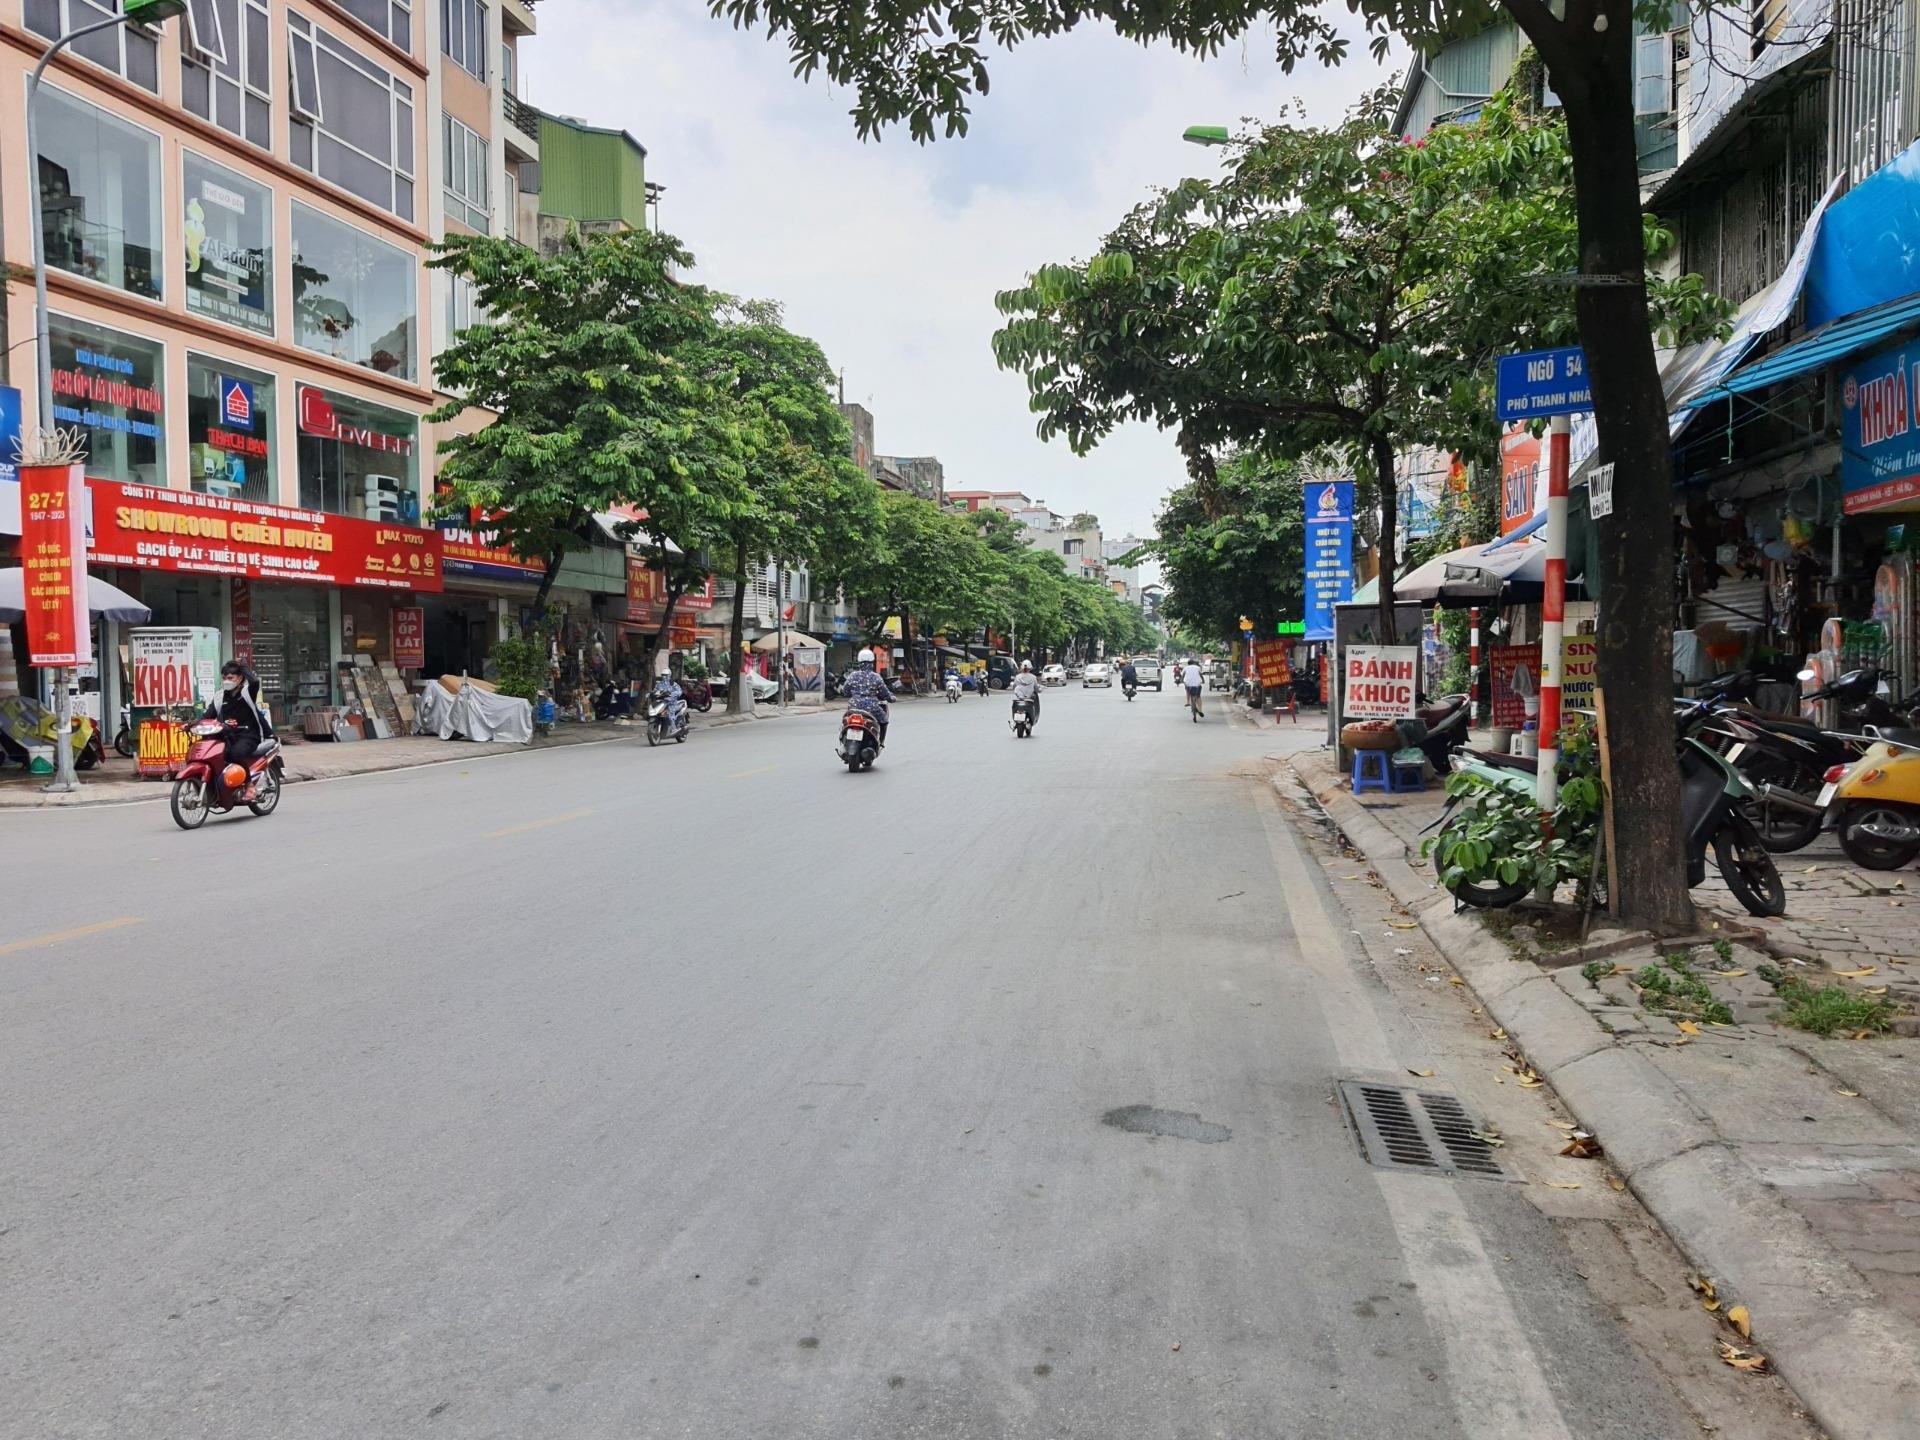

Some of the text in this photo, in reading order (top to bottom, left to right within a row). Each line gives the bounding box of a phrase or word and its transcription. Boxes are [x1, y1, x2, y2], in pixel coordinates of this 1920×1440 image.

[1528, 354, 1582, 382] NGÕ 54
[1507, 386, 1592, 411] PHỐ THANH NHÀ
[1860, 354, 1908, 447] KHOÁ
[144, 488, 154, 499] TY
[157, 490, 177, 502] TNHH
[116, 506, 227, 539] SHOWROOM
[184, 543, 202, 560] LÁT
[284, 557, 302, 570] CAO
[134, 656, 193, 705] KHÓA
[1350, 656, 1412, 680] BÁNH
[1350, 682, 1410, 704] KHÚC
[1564, 682, 1594, 694] NƯỚC
[140, 724, 168, 758] KHÓA
